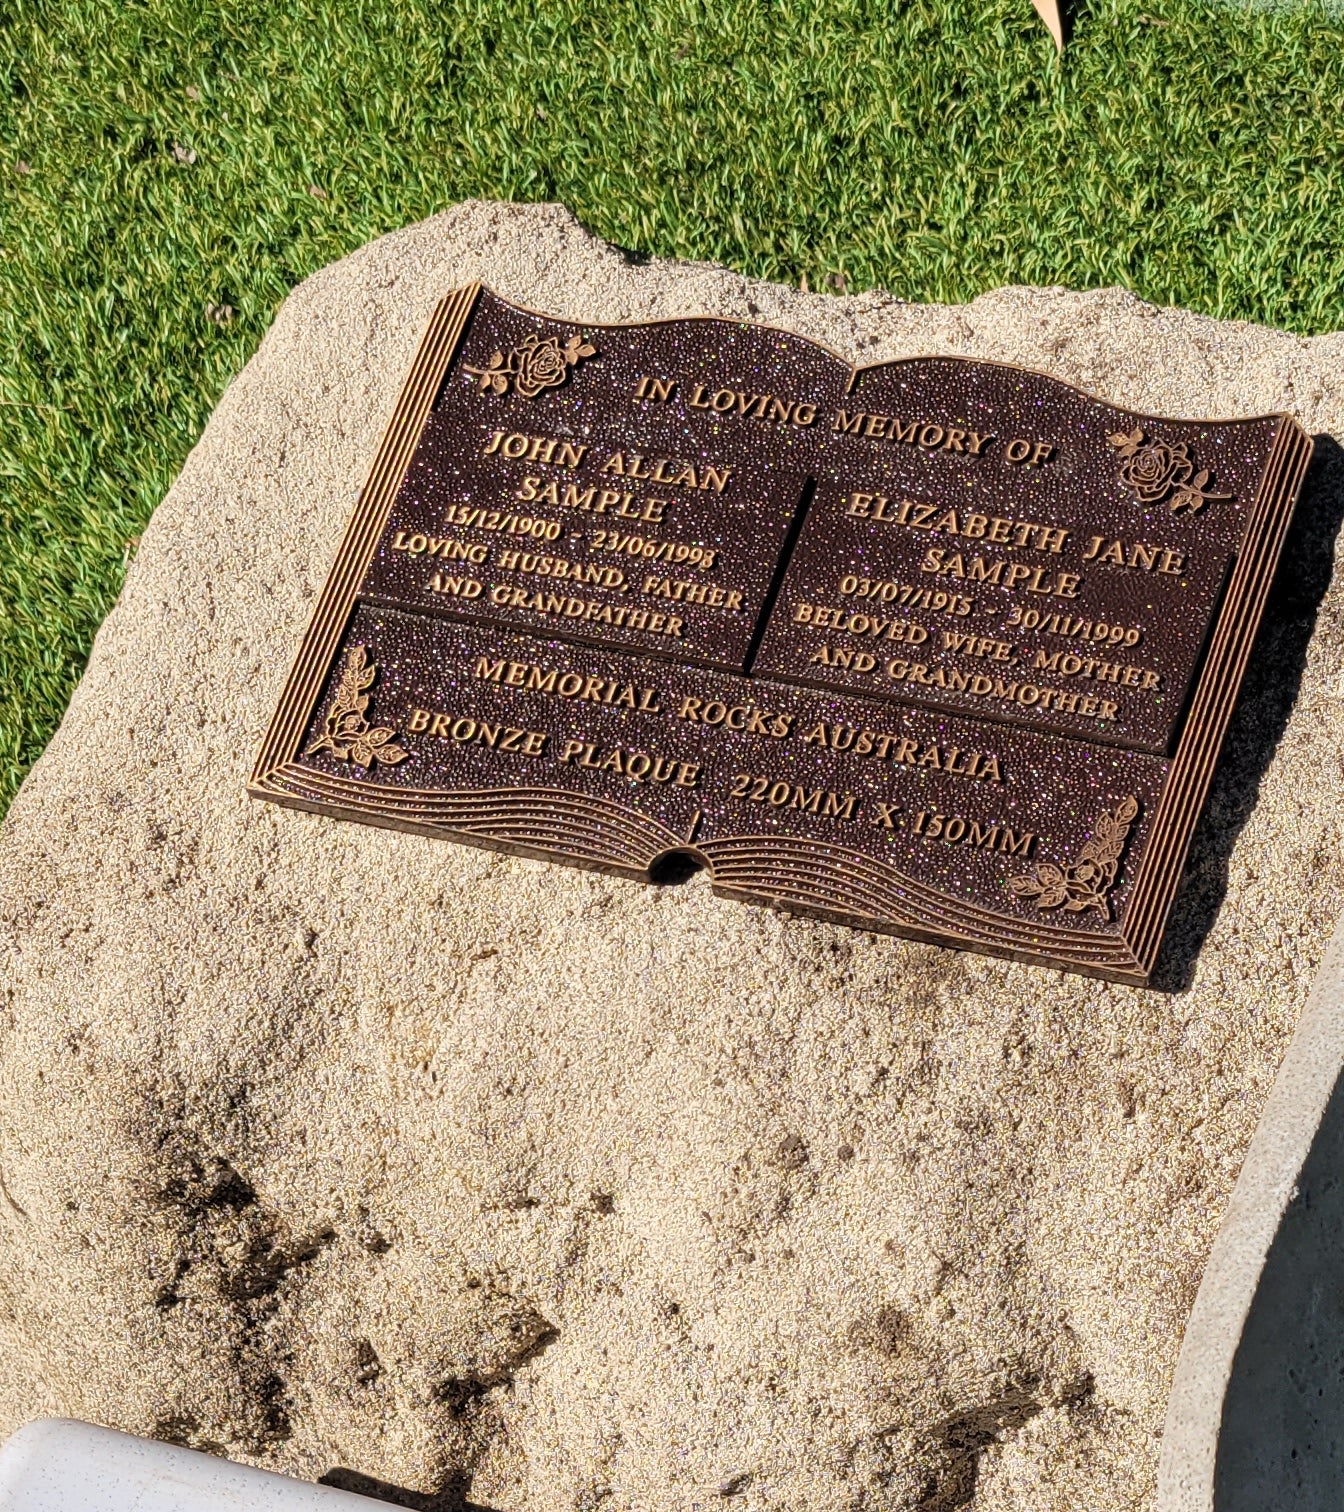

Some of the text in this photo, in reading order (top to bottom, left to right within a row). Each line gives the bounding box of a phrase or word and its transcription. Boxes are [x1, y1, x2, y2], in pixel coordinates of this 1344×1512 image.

[636, 376, 1053, 464] IN LOVING MEMORY OF
[484, 430, 732, 493] JOHN ALLAN
[519, 476, 669, 523] SAMPLE
[392, 531, 744, 610] LOVING HUSBAND, FATHER
[592, 530, 716, 569] 23/06/1998
[846, 493, 1187, 576] ELIZABETH JANE
[428, 574, 685, 637] AND GRANDFATHER
[921, 546, 1082, 600] SAMPLE
[795, 603, 1161, 692] BELOVED WIFE, MOTHER
[840, 575, 977, 617] 03/07/1915
[1006, 606, 1141, 649] 30/11/1999
[475, 656, 1003, 781] MEMORIAL ROCKS AUSTRALIA
[811, 645, 1121, 721] AND GRANDMOTHER
[408, 709, 1037, 858] BRONZE PLAQUE 220MM X 150MM
